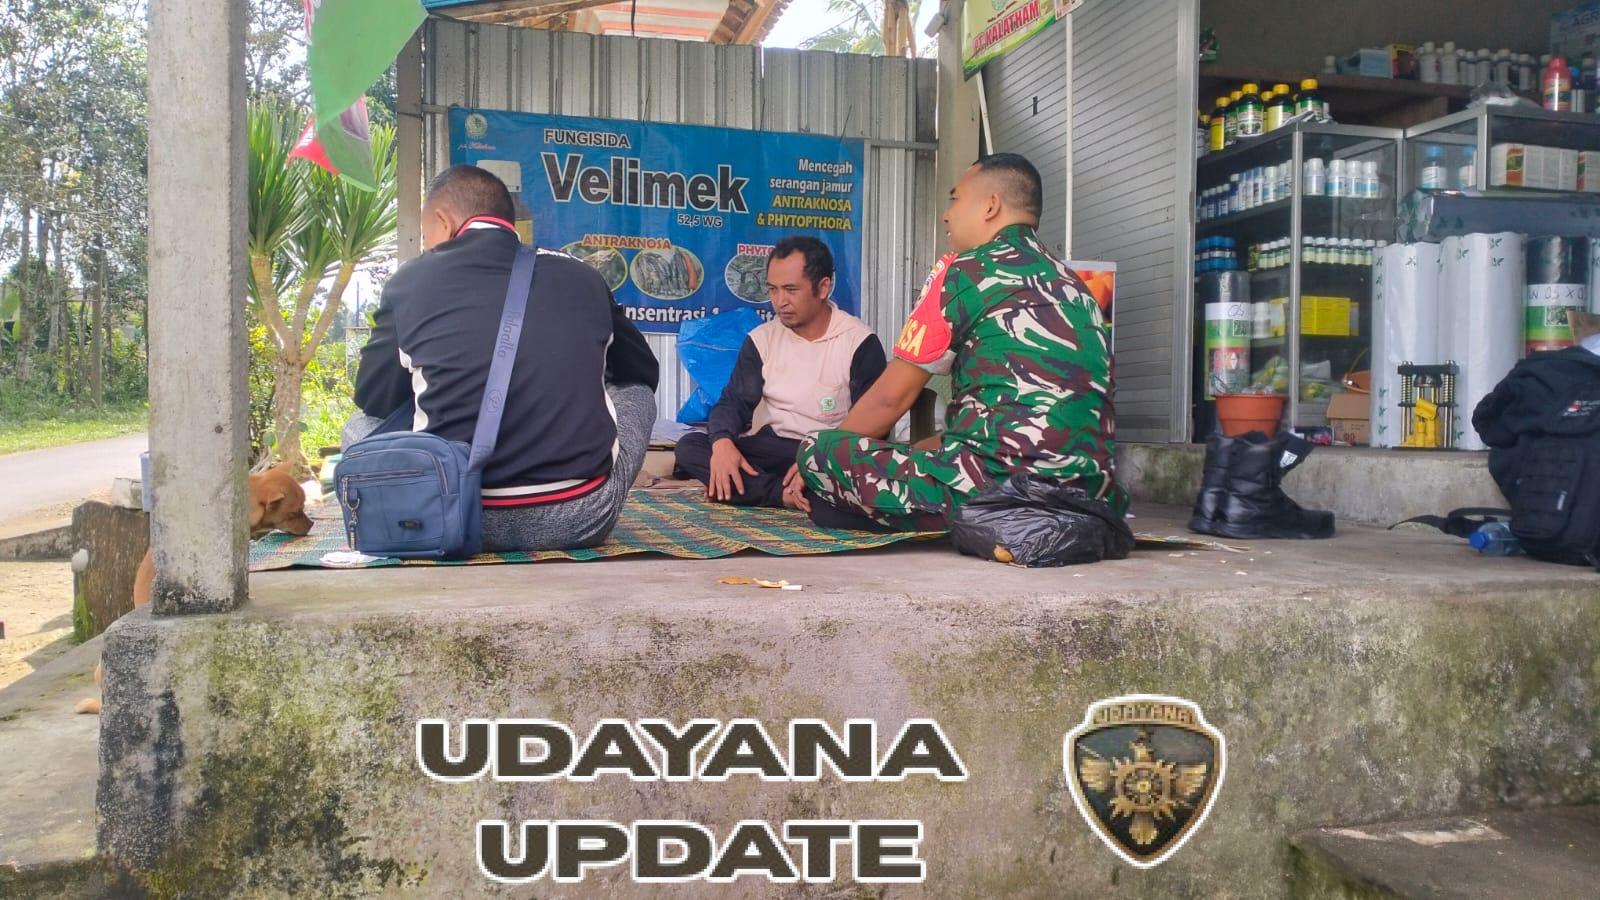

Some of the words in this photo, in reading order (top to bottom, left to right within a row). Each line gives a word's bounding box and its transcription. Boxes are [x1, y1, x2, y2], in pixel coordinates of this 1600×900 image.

[543, 128, 631, 149] FUNGISIDA
[798, 159, 853, 177] Mencegah
[540, 151, 750, 214] Velimek
[769, 178, 820, 193] serangan
[821, 179, 853, 194] jamur
[772, 195, 852, 212] ANTRAKNOSA
[677, 214, 700, 226] 52,5
[702, 215, 723, 227] WG
[757, 213, 765, 225] &
[768, 213, 852, 230] PHYTOPTHORA
[581, 233, 672, 250] ANTRAKNOSA
